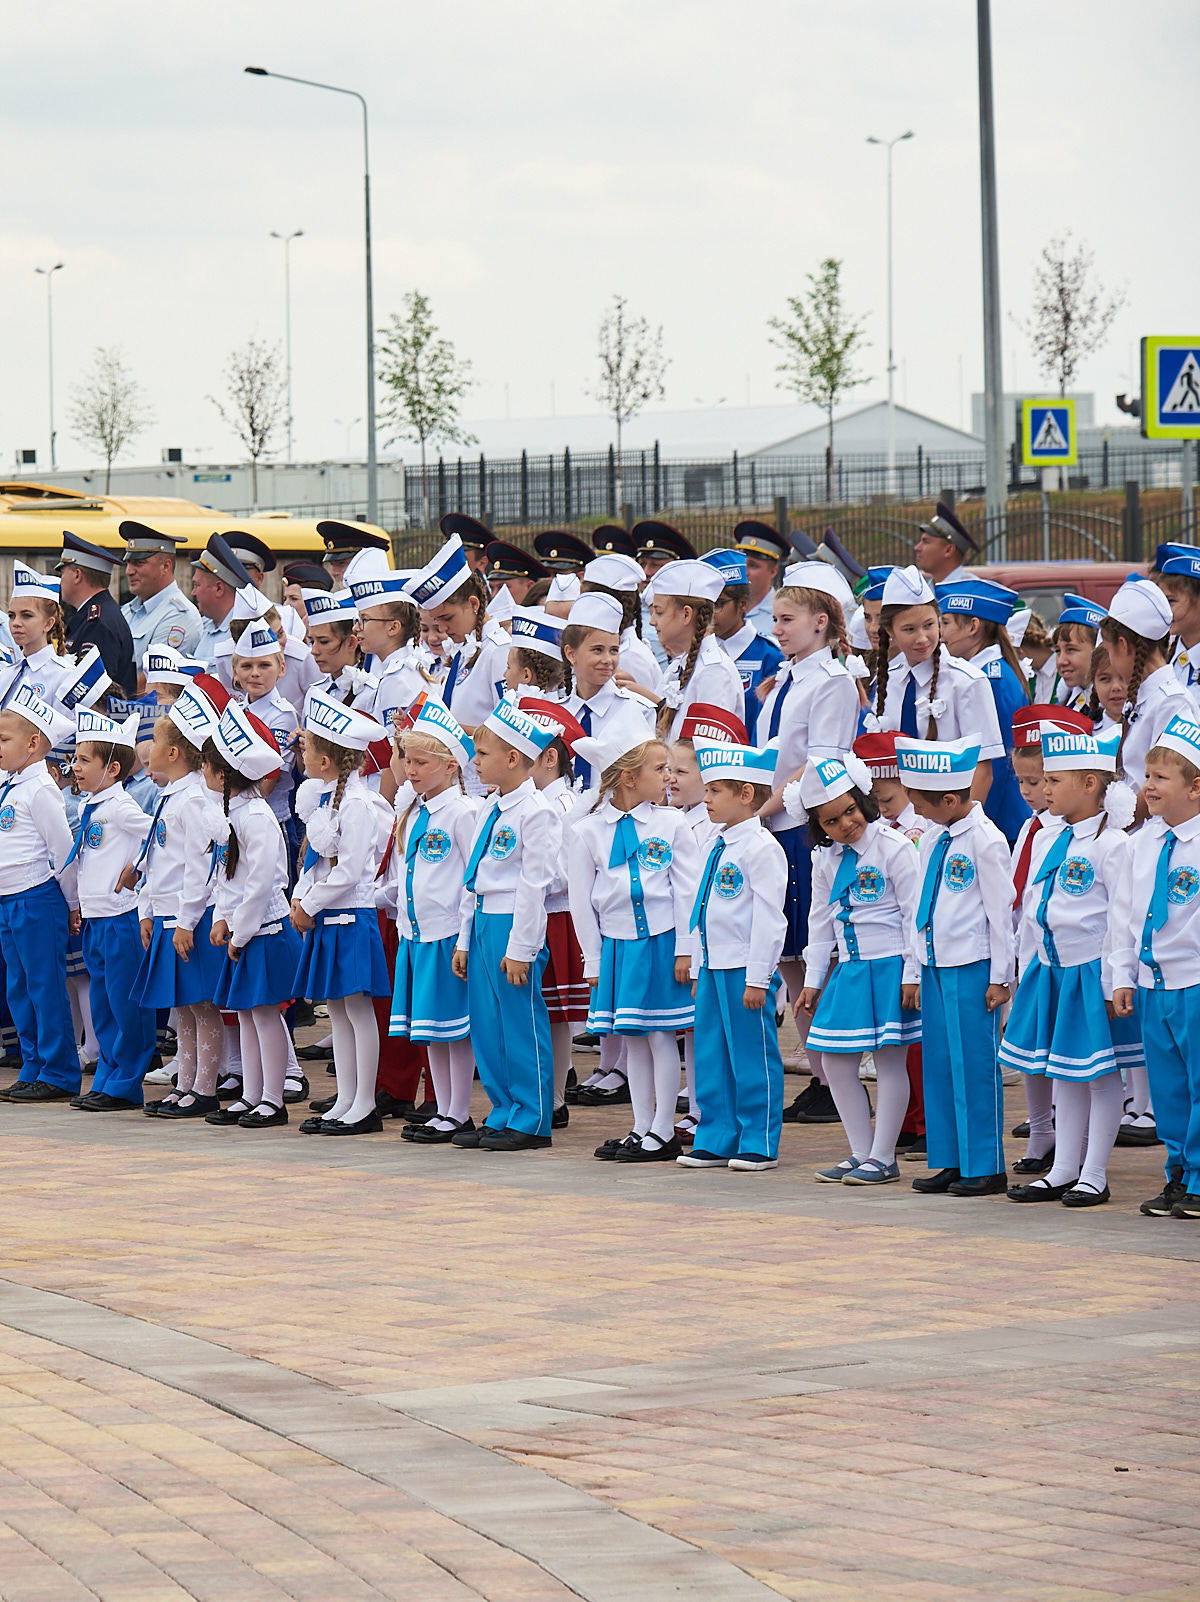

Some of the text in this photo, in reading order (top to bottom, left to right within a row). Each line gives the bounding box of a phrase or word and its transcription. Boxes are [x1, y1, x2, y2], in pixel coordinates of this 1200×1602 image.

[353, 581, 384, 598] ЮИД
[415, 576, 445, 600] ЮИД
[310, 598, 340, 612] ЮИД
[950, 598, 970, 609] ЮИД
[1088, 612, 1103, 622] ЮИ
[424, 705, 465, 740] ЮПИД
[497, 702, 534, 738] ЮПИД
[1171, 720, 1200, 745] ЮП
[1048, 735, 1099, 753] ЮПИД
[700, 751, 744, 767] ЮПИД
[902, 754, 951, 772] ЮПИД
